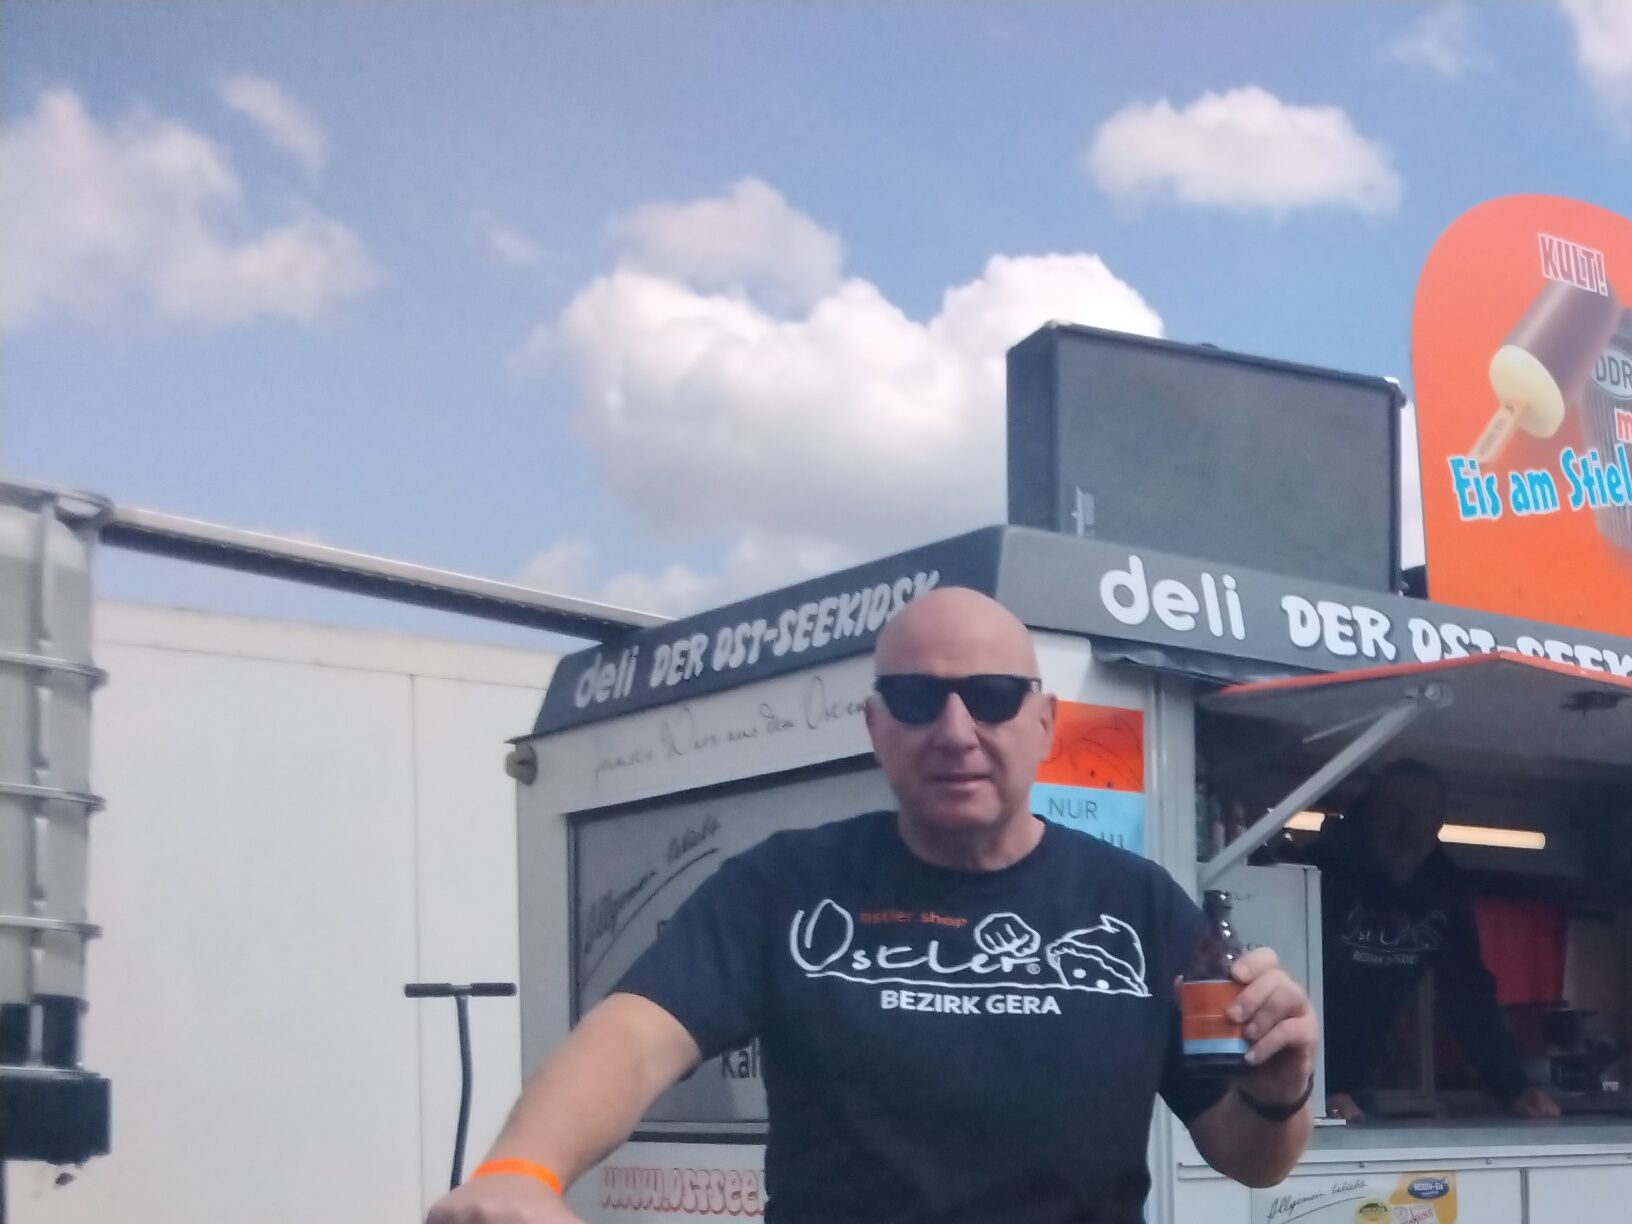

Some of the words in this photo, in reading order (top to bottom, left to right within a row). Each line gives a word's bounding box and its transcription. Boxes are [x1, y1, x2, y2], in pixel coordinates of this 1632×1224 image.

[1537, 233, 1608, 296] KULT!
[1448, 456, 1502, 521] Eis
[1509, 467, 1561, 517] am
[1099, 555, 1246, 641] deli
[1281, 594, 1397, 661] DER
[575, 646, 639, 708] deli
[649, 634, 709, 688] DER
[1048, 797, 1098, 819] NUR
[880, 989, 982, 1015] BEZIRK
[985, 993, 1062, 1016] GERA
